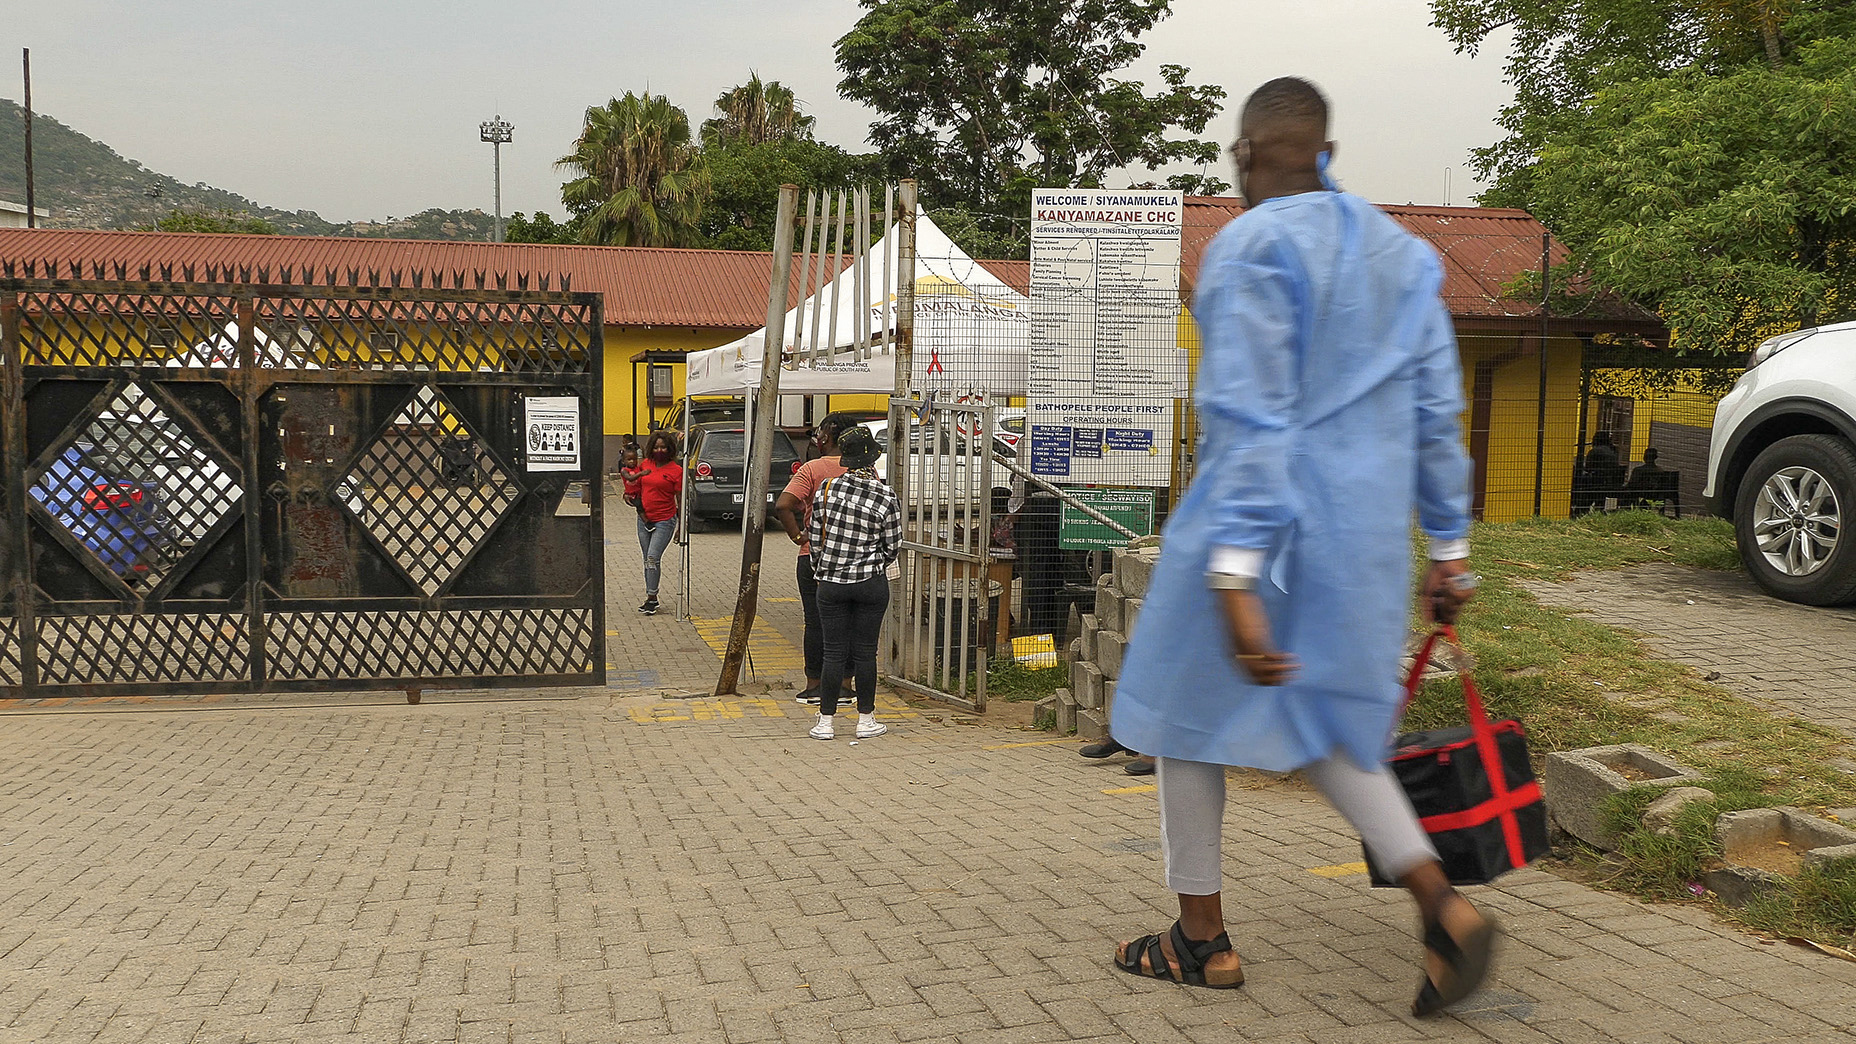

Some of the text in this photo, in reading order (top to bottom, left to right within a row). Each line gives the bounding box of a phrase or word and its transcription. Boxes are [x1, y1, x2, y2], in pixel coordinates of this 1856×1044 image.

[1036, 196, 1178, 206] WELCOME / SIYANAMUKELA
[1037, 210, 1176, 222] KANYAMAZANE CHC
[1035, 404, 1164, 414] BATHOPELE PEOPLE FIRST
